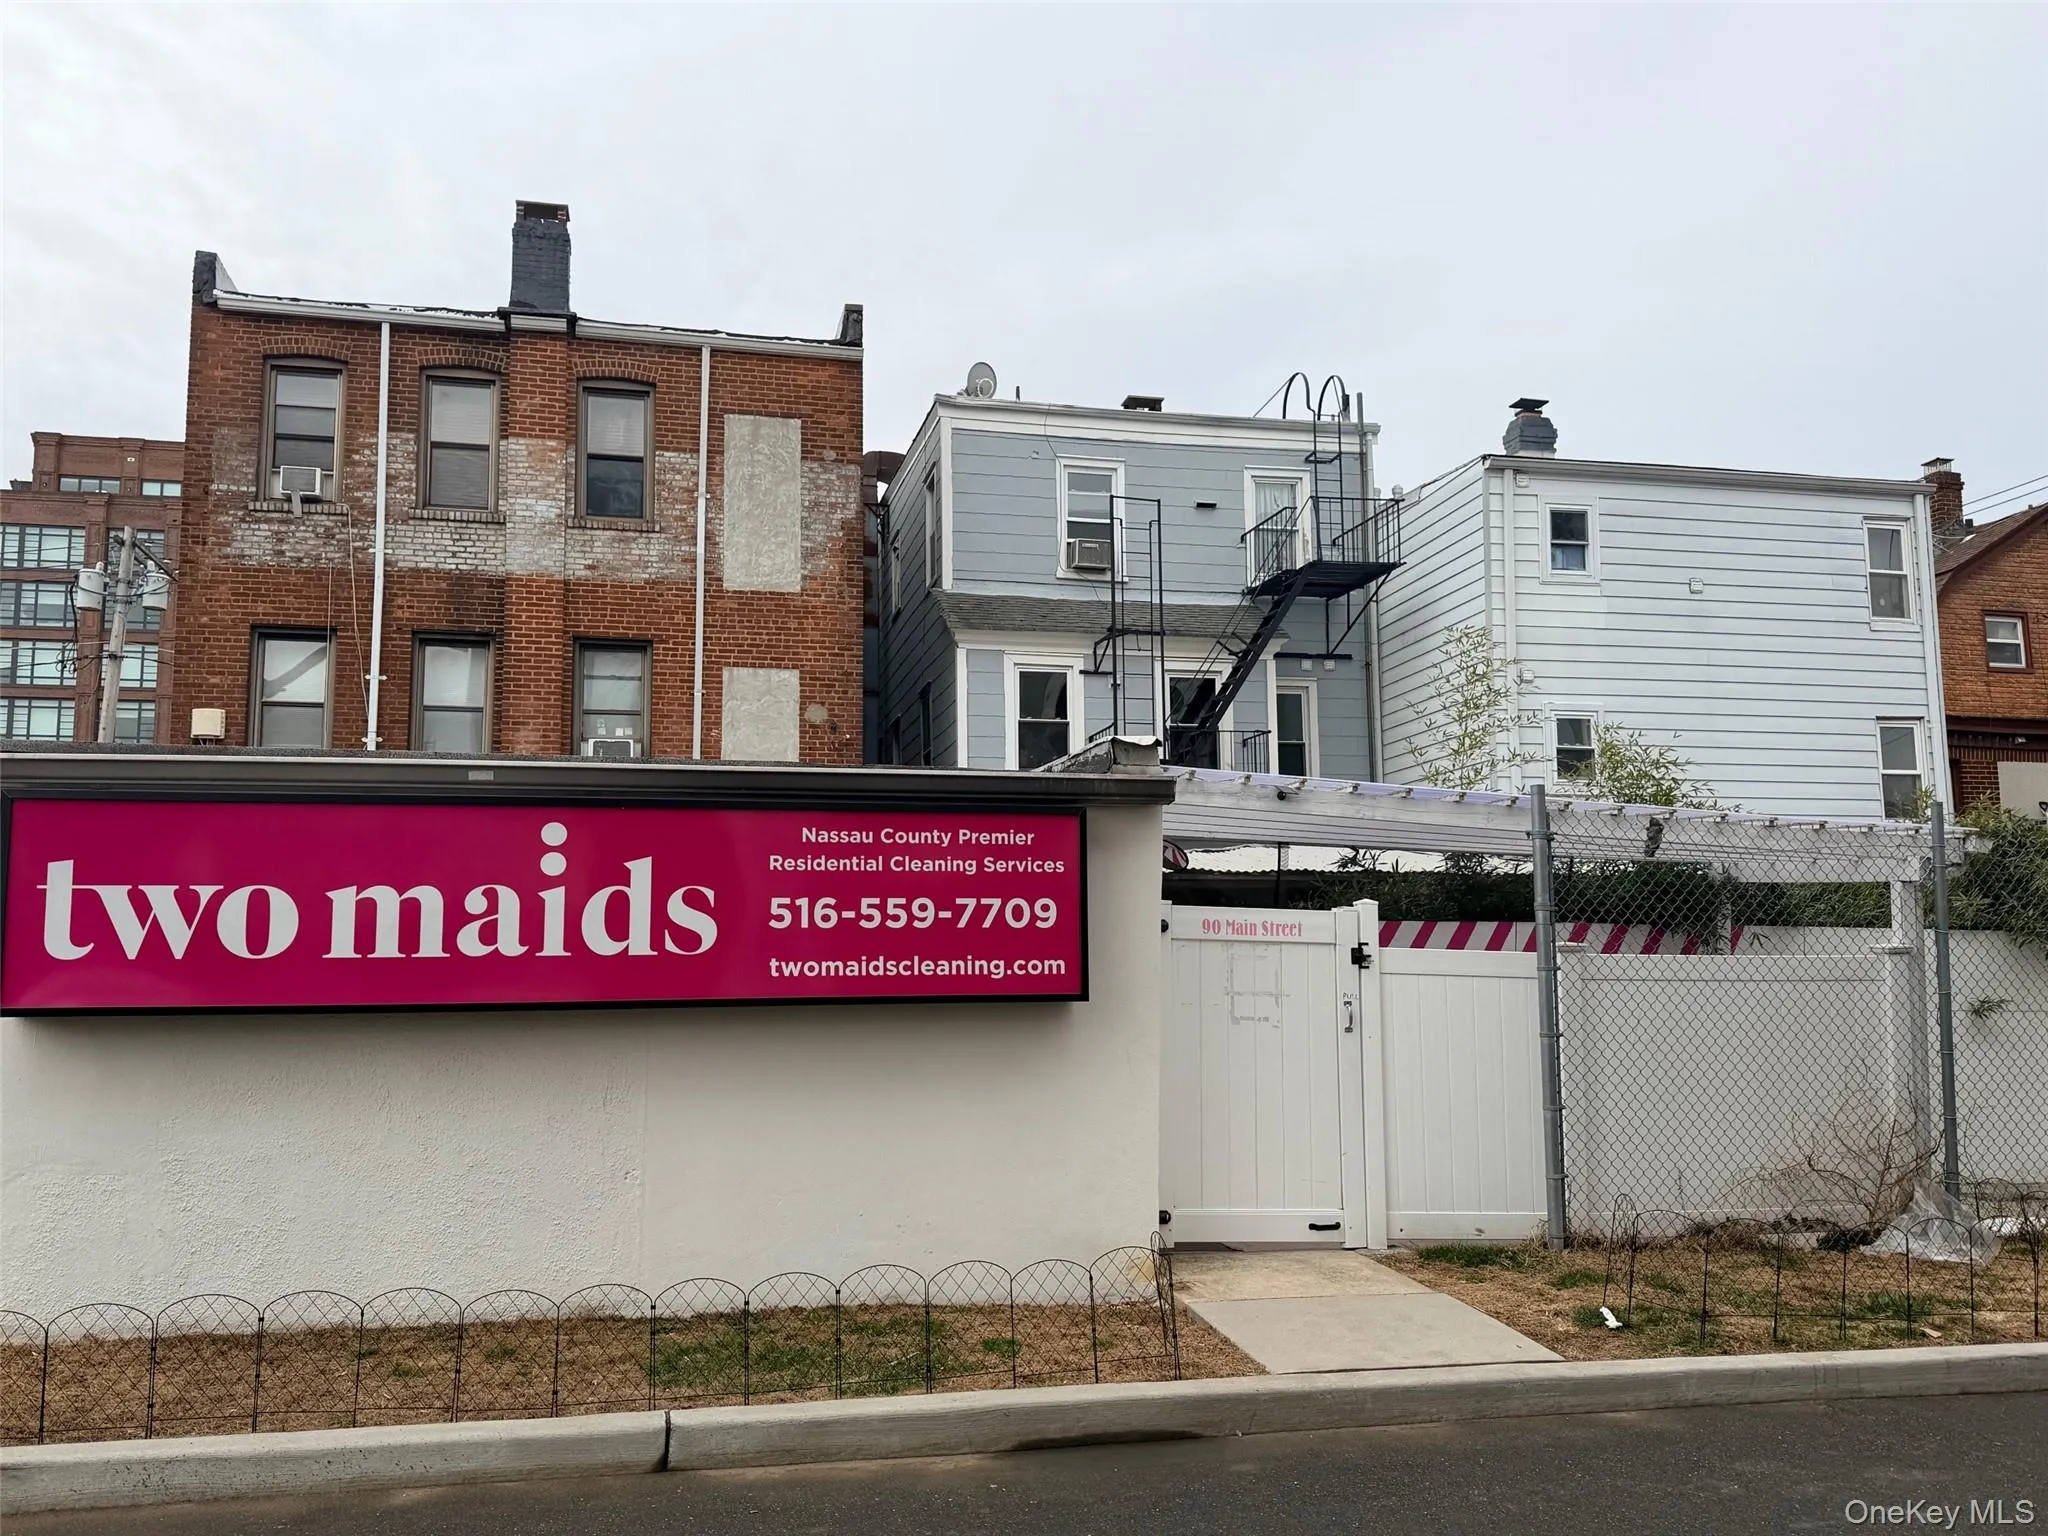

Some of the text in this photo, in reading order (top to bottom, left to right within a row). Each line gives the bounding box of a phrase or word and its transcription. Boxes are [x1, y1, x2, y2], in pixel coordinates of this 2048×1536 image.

[801, 826, 1035, 847] Nassau County Premier
[768, 854, 1066, 875] Residential Cleaning Services
[37, 822, 718, 961] two maids
[767, 896, 1058, 930] 516-559-7709
[1202, 918, 1303, 937] 90 Main Street
[768, 954, 1067, 980] twomaidscleaning.com
